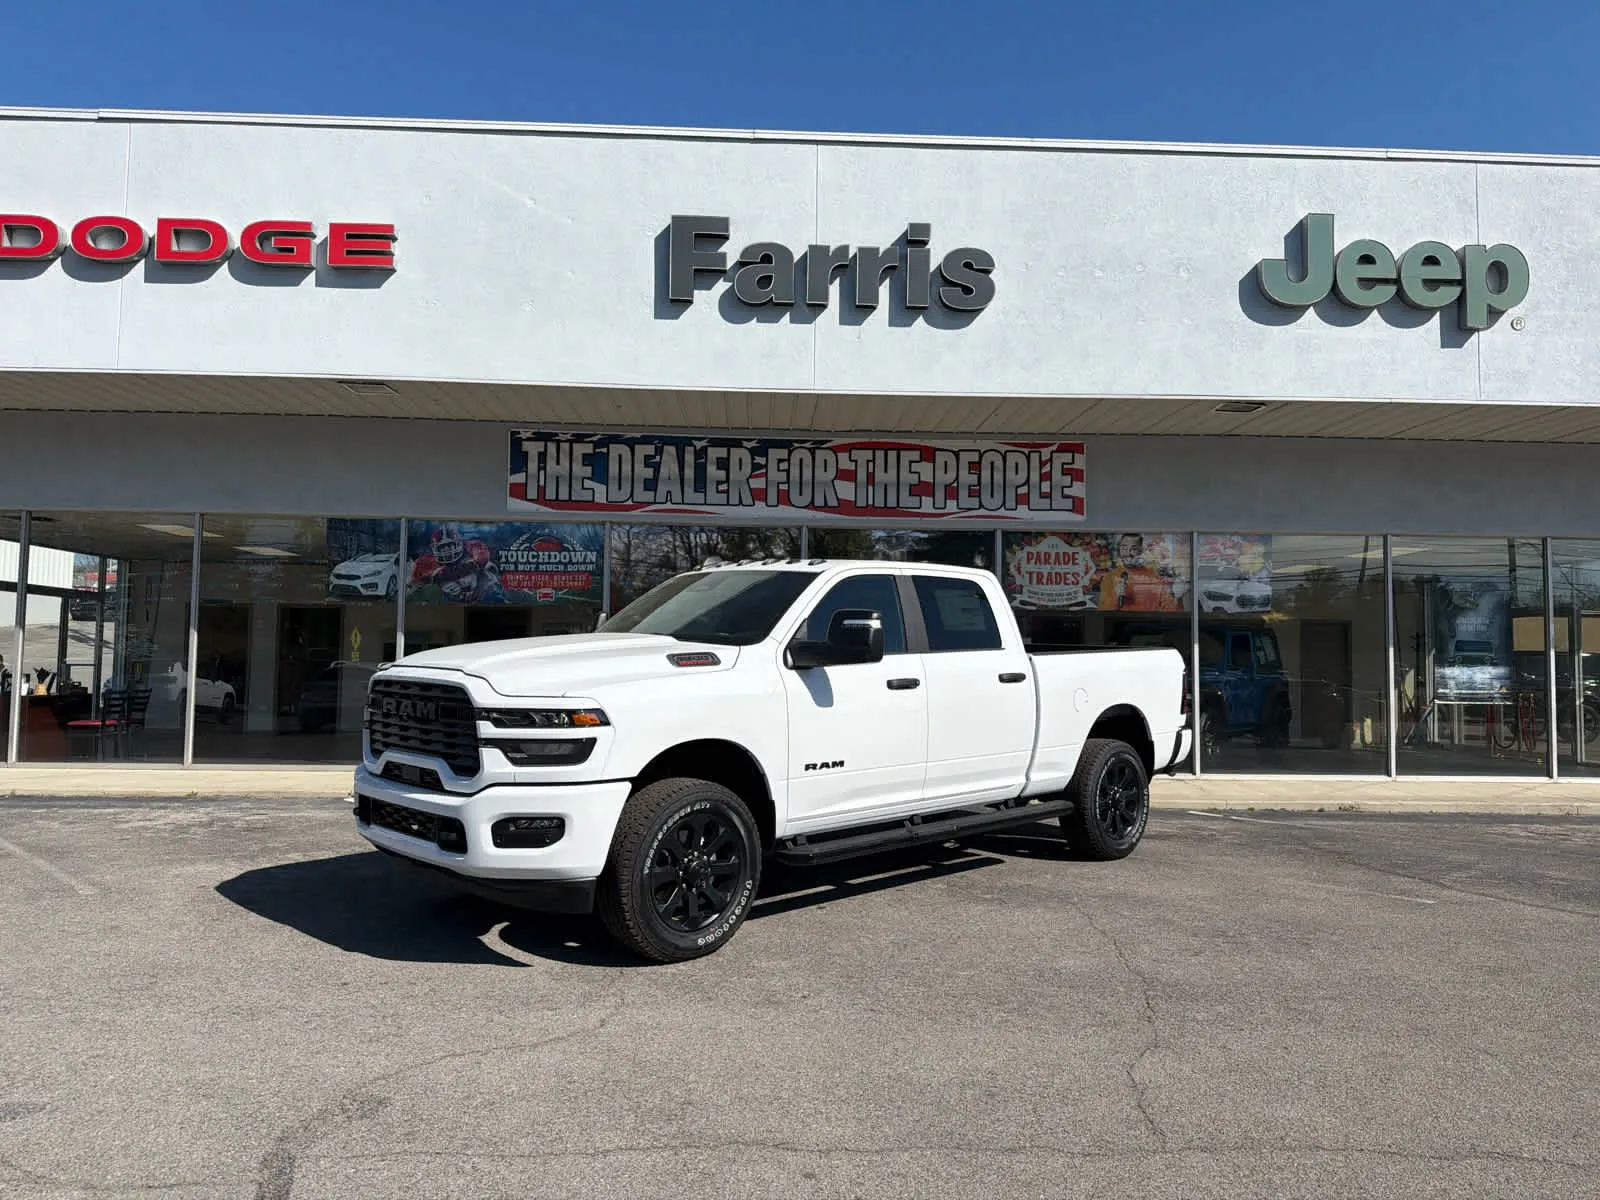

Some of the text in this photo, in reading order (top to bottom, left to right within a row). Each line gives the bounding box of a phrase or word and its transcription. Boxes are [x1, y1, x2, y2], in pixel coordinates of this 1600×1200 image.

[0, 213, 396, 272] DODGE
[668, 214, 996, 312] Farris
[1258, 212, 1530, 330] Jeep
[521, 440, 1075, 512] THE DEALER FOR THE PEOPLE
[498, 551, 597, 563] TOUCHDOWN
[1026, 551, 1080, 566] PARADE
[1025, 570, 1080, 586] TRADES
[383, 697, 436, 721] RAM
[804, 760, 845, 772] RAM
